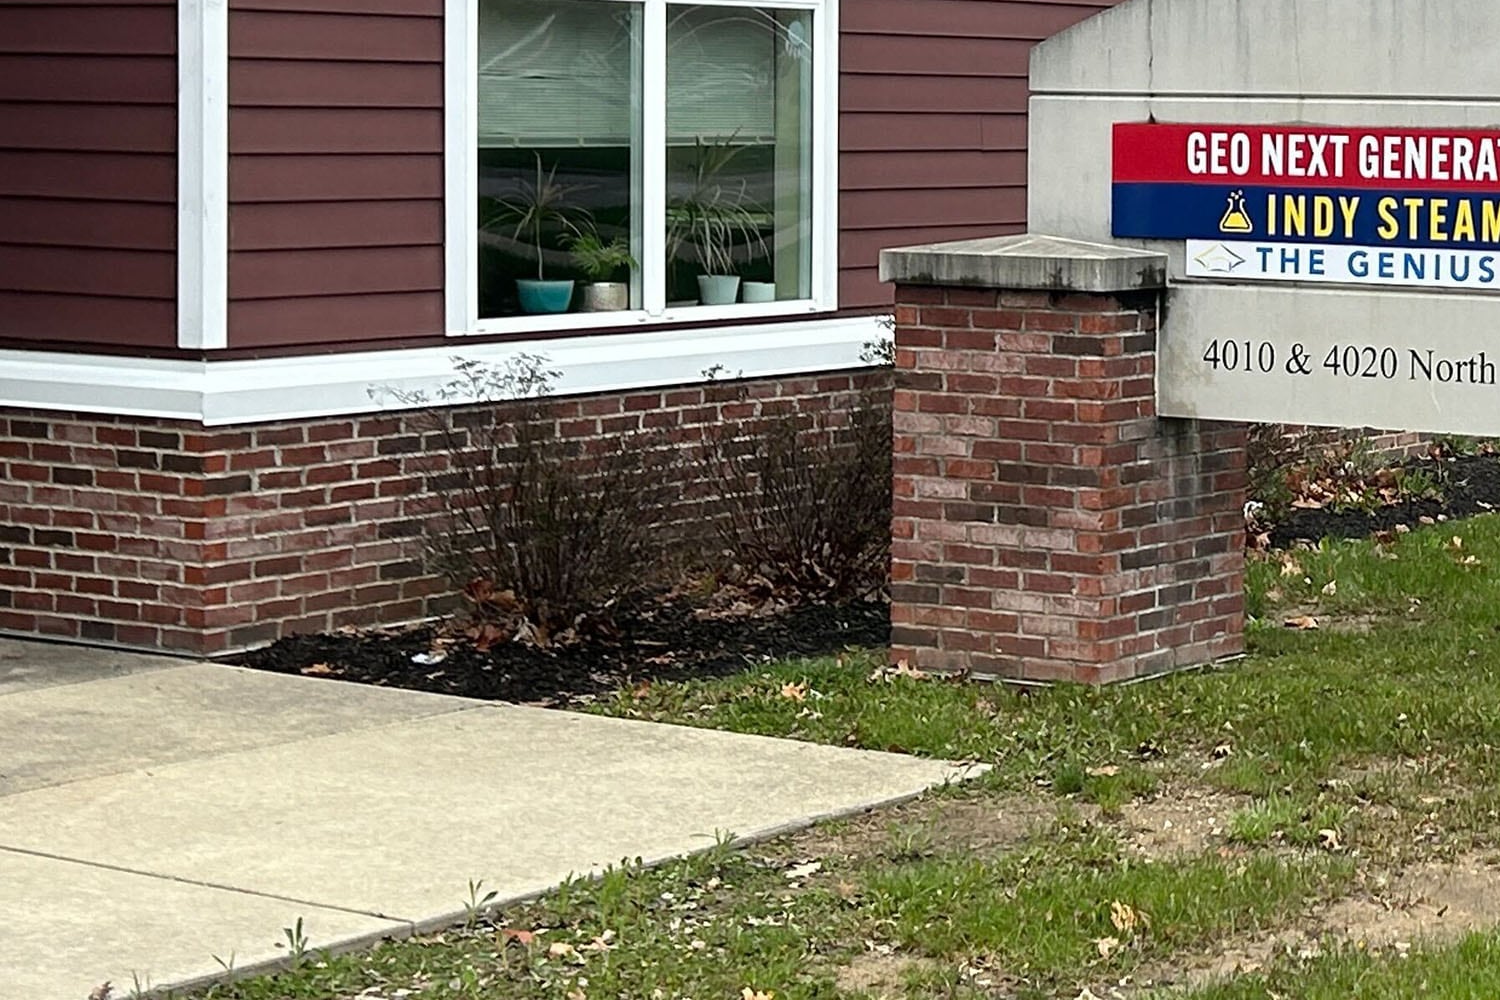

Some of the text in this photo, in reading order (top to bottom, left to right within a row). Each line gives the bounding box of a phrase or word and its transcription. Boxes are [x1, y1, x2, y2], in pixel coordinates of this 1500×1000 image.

[1186, 131, 1251, 176] GEO
[1261, 133, 1349, 178] NEXT
[1267, 193, 1360, 239] INDY
[1256, 247, 1325, 275] THE
[1347, 250, 1495, 283] GENIUS
[1203, 339, 1275, 373] 4010
[1285, 343, 1312, 375] &
[1323, 345, 1398, 379] 4020
[1408, 348, 1496, 385] North
